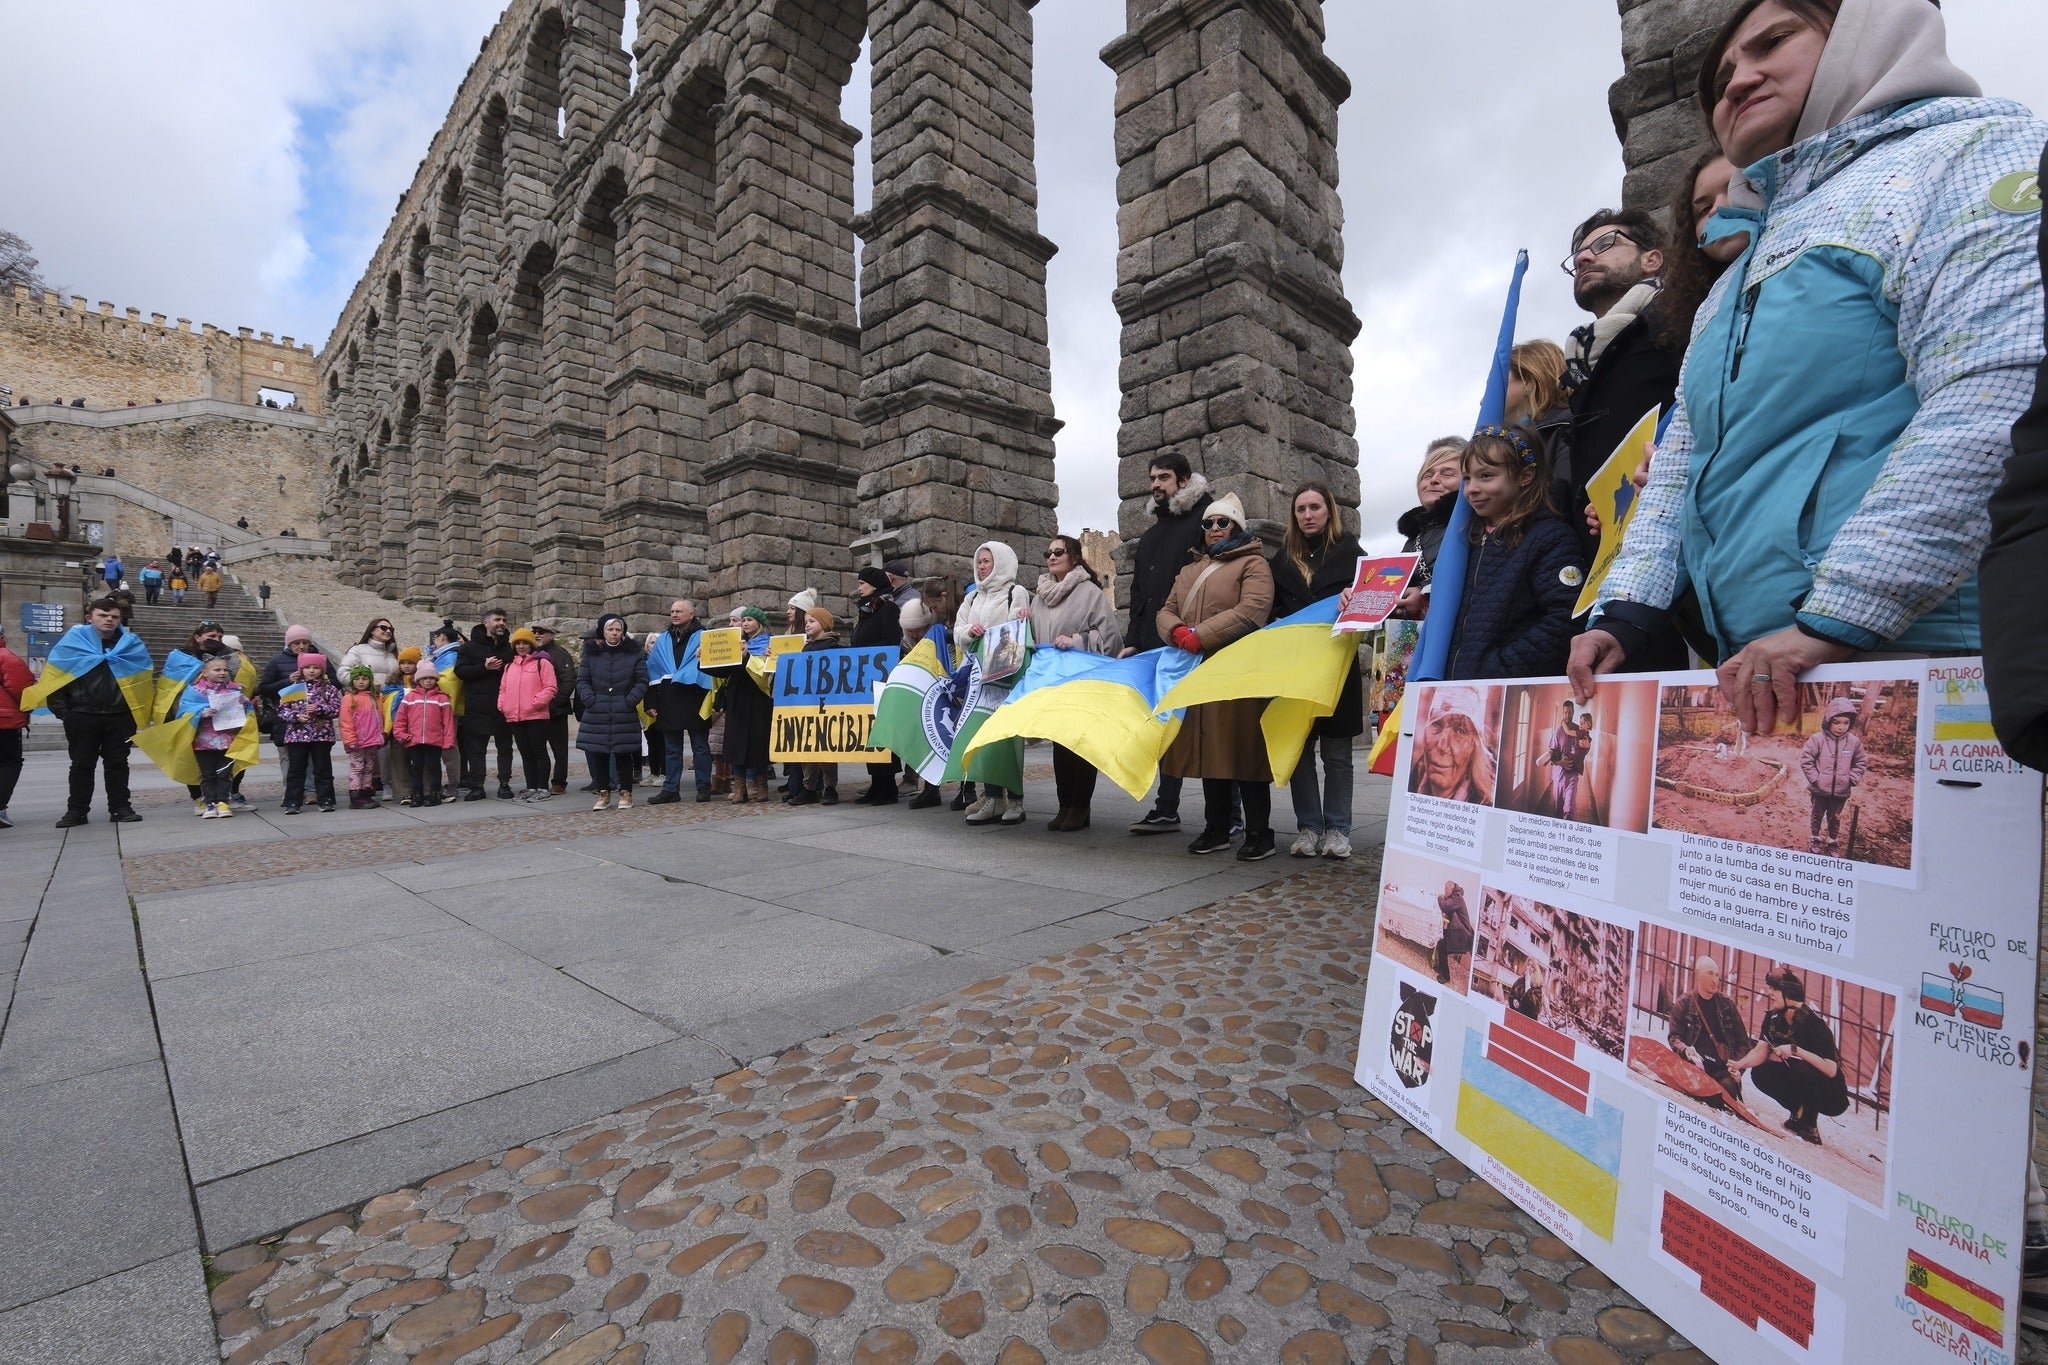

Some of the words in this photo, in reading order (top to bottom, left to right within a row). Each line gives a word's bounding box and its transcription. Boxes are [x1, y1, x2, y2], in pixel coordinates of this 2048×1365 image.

[1929, 667, 1983, 681] FUTURO
[819, 698, 826, 714] E
[774, 711, 886, 752] INVENCIBLE
[1925, 744, 1944, 756] VA
[1951, 745, 1959, 756] A
[1929, 759, 1947, 771] LA
[1529, 817, 1550, 826] médico
[1552, 821, 1567, 829] lleva
[1575, 825, 1591, 833] Jana
[1548, 831, 1556, 839] de
[1567, 835, 1585, 845] años,
[1588, 839, 1601, 847] que
[1508, 837, 1525, 845] perdió
[1527, 840, 1547, 849] ambas
[1549, 844, 1573, 854] piernas
[1575, 848, 1602, 860] durante
[1515, 849, 1535, 858] ataque
[1550, 856, 1575, 867] cohetes
[1577, 861, 1586, 869] de
[1588, 862, 1598, 872] los
[1680, 847, 1702, 859] junto
[1715, 854, 1722, 863] la
[1726, 856, 1758, 870] tumba
[1761, 863, 1774, 873] de
[1778, 867, 1791, 877] su
[1796, 870, 1833, 884] madre
[1838, 879, 1853, 888] en
[1682, 834, 1695, 843] Un
[1698, 837, 1718, 848] niño
[1721, 841, 1733, 850] de
[1737, 843, 1742, 852] 6
[1746, 846, 1771, 857] años
[1775, 851, 1788, 860] se
[1792, 854, 1853, 871] encuentra
[1506, 859, 1521, 867] rusos
[1529, 862, 1534, 870] la
[1536, 865, 1562, 876] estación
[1575, 873, 1588, 882] tren
[1529, 874, 1565, 888] Kramatorsk
[1679, 862, 1687, 870] el
[1689, 865, 1712, 876] patio
[1715, 869, 1727, 879] de
[1731, 874, 1742, 882] su
[1746, 876, 1770, 888] casa
[1774, 883, 1788, 892] en
[1792, 884, 1833, 901] Bucha.
[1838, 893, 1853, 905] La
[1680, 878, 1705, 889] mujer
[1709, 883, 1736, 896] murió
[1739, 889, 1752, 900] de
[1756, 892, 1797, 910] hambre
[1802, 904, 1808, 915] y
[1812, 906, 1850, 922] estrés
[1680, 891, 1711, 905] debido
[1724, 900, 1732, 910] la
[1735, 904, 1772, 920] guerra.
[1777, 912, 1787, 924] El
[1791, 917, 1816, 931] niño
[1820, 923, 1847, 939] trajo
[1683, 907, 1716, 921] comida
[1720, 916, 1764, 934] enlatada
[1778, 932, 1791, 941] su
[1795, 935, 1833, 951] tumba
[1930, 922, 1996, 948] FUTURO
[2008, 939, 2028, 954] DE
[1403, 1037, 1417, 1055] THE
[1915, 1012, 1939, 1028] NO
[1944, 1020, 2011, 1050] TIENES
[1391, 1044, 1425, 1086] WAR
[1666, 1116, 1685, 1133] leyó
[1688, 1130, 1737, 1161] oraciones
[1740, 1158, 1772, 1180] sobre
[1776, 1175, 1785, 1187] el
[1790, 1181, 1811, 1201] hijo
[1668, 1102, 1676, 1114] El
[1679, 1110, 1706, 1130] padre
[1710, 1124, 1750, 1151] durante
[1754, 1147, 1774, 1164] dos
[1778, 1158, 1812, 1184] horas
[1488, 1156, 1504, 1175] Putin
[1506, 1171, 1523, 1189] mata
[1533, 1191, 1555, 1213] civiles
[1558, 1210, 1568, 1221] en
[1658, 1144, 1688, 1166] policía
[1691, 1162, 1731, 1190] sostuvo
[1734, 1184, 1743, 1197] la
[1747, 1193, 1779, 1218] mano
[1782, 1212, 1797, 1228] de
[1801, 1224, 1816, 1239] su
[1664, 1132, 1700, 1158] muerto,
[1704, 1152, 1726, 1171] todo
[1730, 1169, 1752, 1186] este
[1756, 1181, 1795, 1209] tiempo
[1800, 1203, 1810, 1218] la
[1481, 1165, 1506, 1190] Ucrania
[1509, 1187, 1535, 1212] durante
[1538, 1208, 1551, 1224] dos
[1554, 1221, 1573, 1240] años
[1709, 1188, 1750, 1218] esposo.
[1664, 1193, 1700, 1224] Gracias
[1714, 1224, 1728, 1241] los
[1732, 1239, 1790, 1281] españoles
[1795, 1278, 1815, 1295] por
[1898, 1191, 1974, 1239] FUTURO
[1982, 1233, 2006, 1259] DE
[1661, 1224, 1693, 1249] ayudar
[1696, 1249, 1709, 1260] en
[1712, 1255, 1720, 1269] la
[1725, 1262, 1770, 1303] barbarie
[1775, 1300, 1813, 1331] contra
[1663, 1209, 1695, 1235] ayudar
[1708, 1236, 1723, 1254] los
[1727, 1251, 1789, 1297] ucranianos
[1793, 1295, 1814, 1312] por
[1663, 1238, 1689, 1261] Rusia
[1693, 1261, 1708, 1275] del
[1711, 1273, 1747, 1304] estado
[1751, 1300, 1803, 1342] terrorista
[1701, 1279, 1727, 1304] Putin
[1895, 1295, 1917, 1316] NO
[1922, 1309, 1953, 1336] VAN
[1958, 1332, 1971, 1349] A
